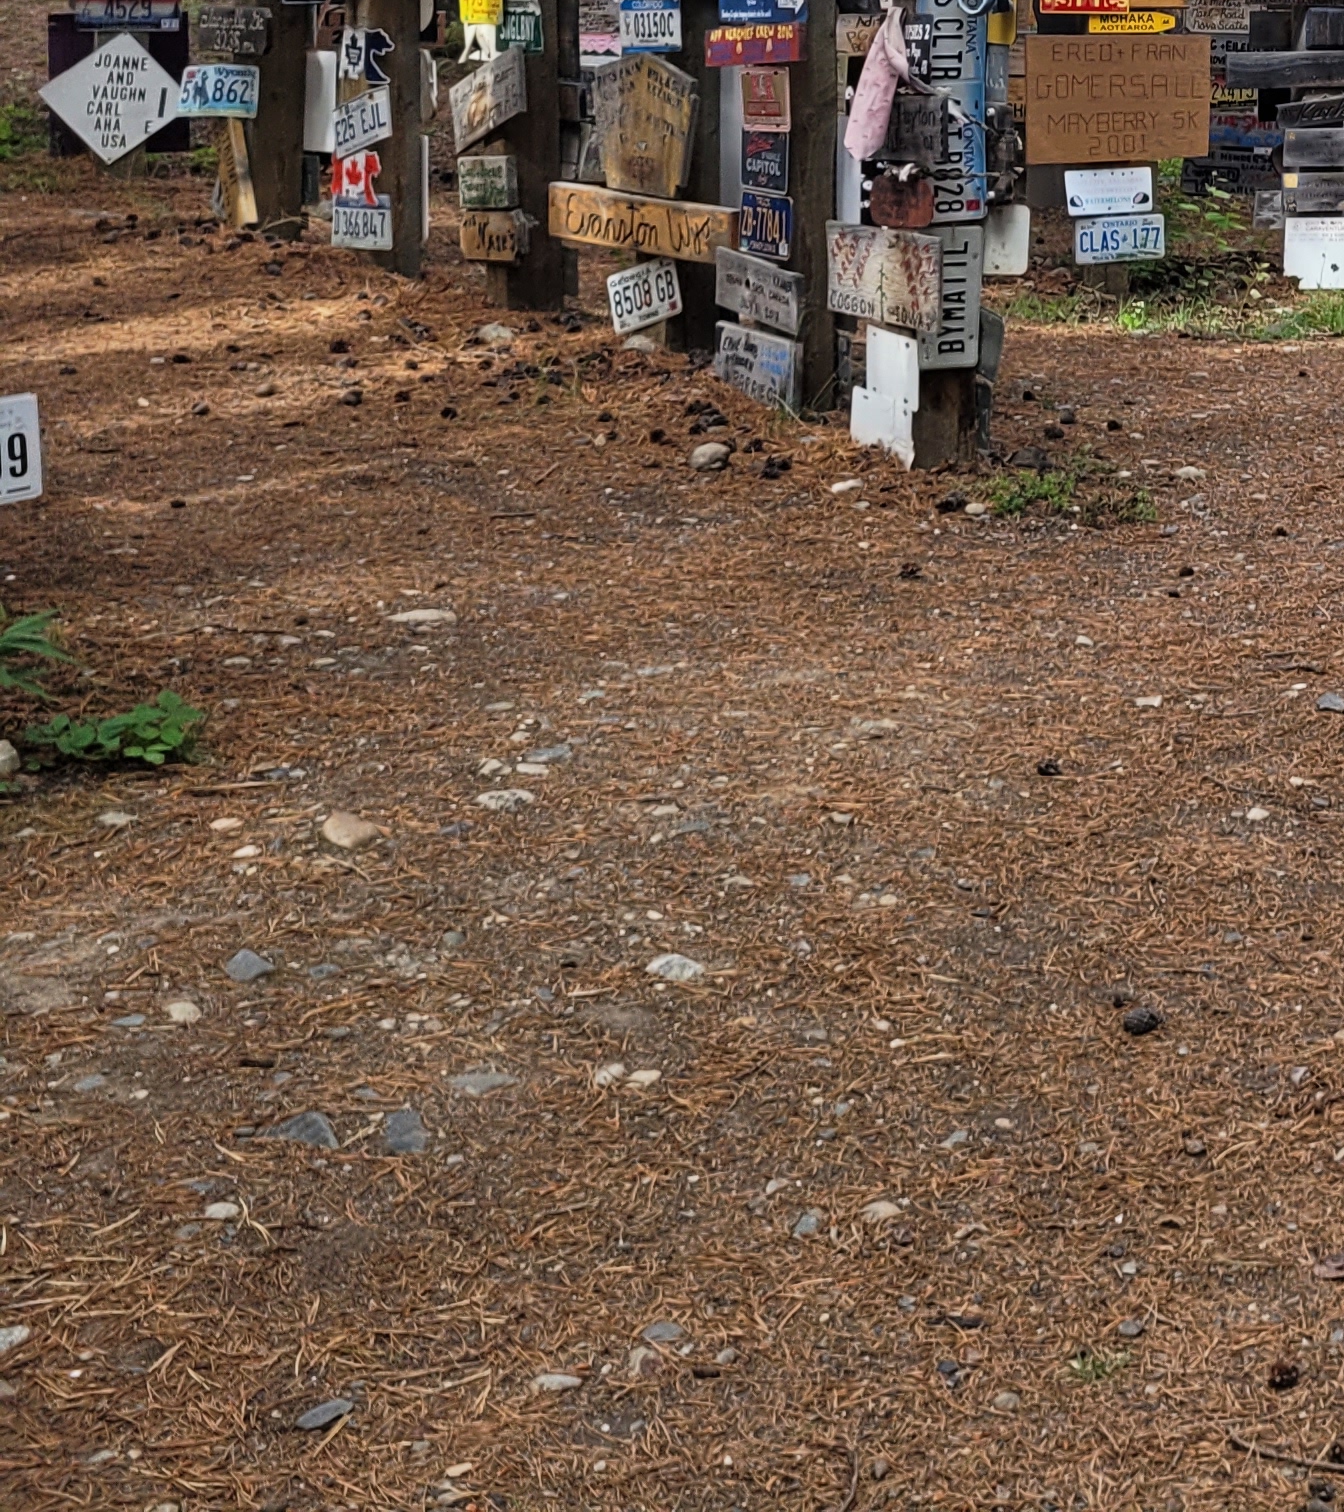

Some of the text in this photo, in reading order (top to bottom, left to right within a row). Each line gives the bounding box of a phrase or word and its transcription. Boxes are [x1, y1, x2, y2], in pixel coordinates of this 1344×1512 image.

[1100, 13, 1155, 24] MOHAKA
[94, 54, 149, 72] JOANNE
[92, 87, 146, 103] VAUGHN
[86, 101, 121, 117] CARL
[566, 199, 658, 249] Evanston
